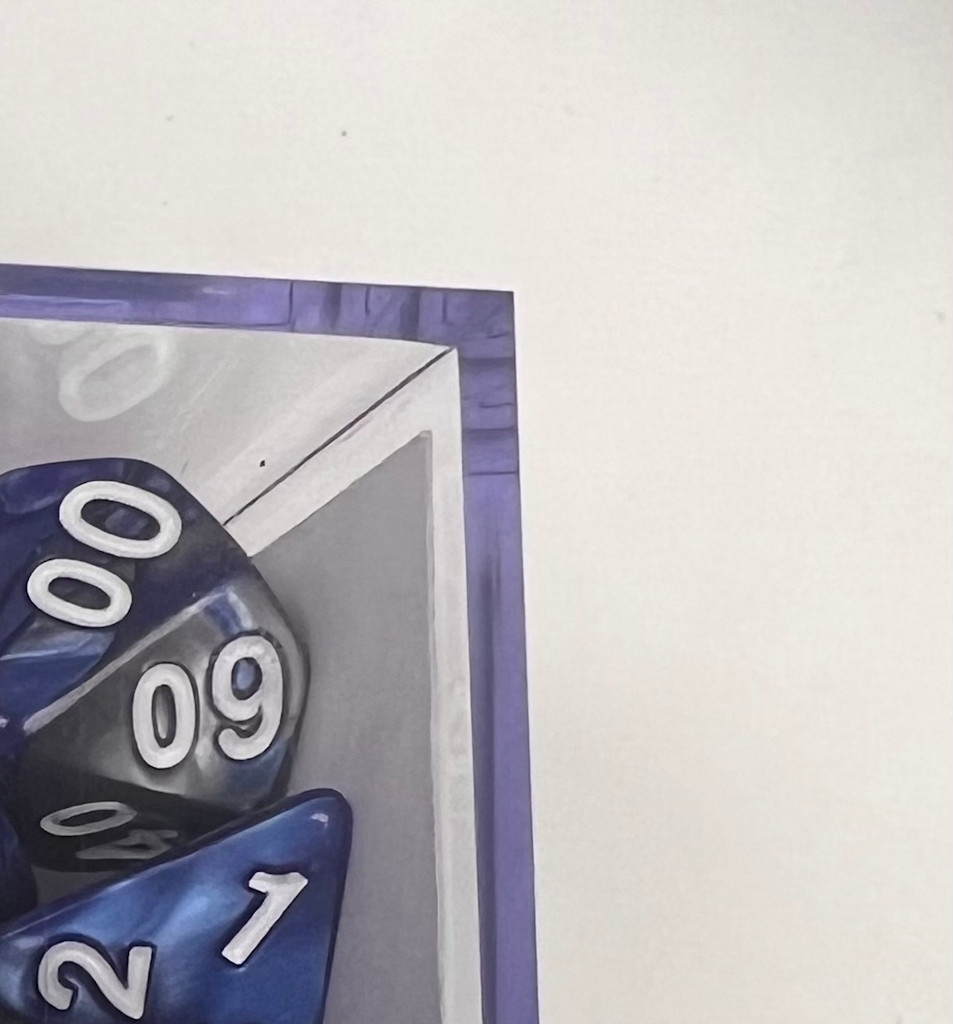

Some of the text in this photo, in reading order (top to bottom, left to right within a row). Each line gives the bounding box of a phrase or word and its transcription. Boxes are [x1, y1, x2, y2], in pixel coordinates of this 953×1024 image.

[26, 480, 182, 628] 00
[221, 871, 308, 966] 1
[38, 940, 152, 1020] 2
